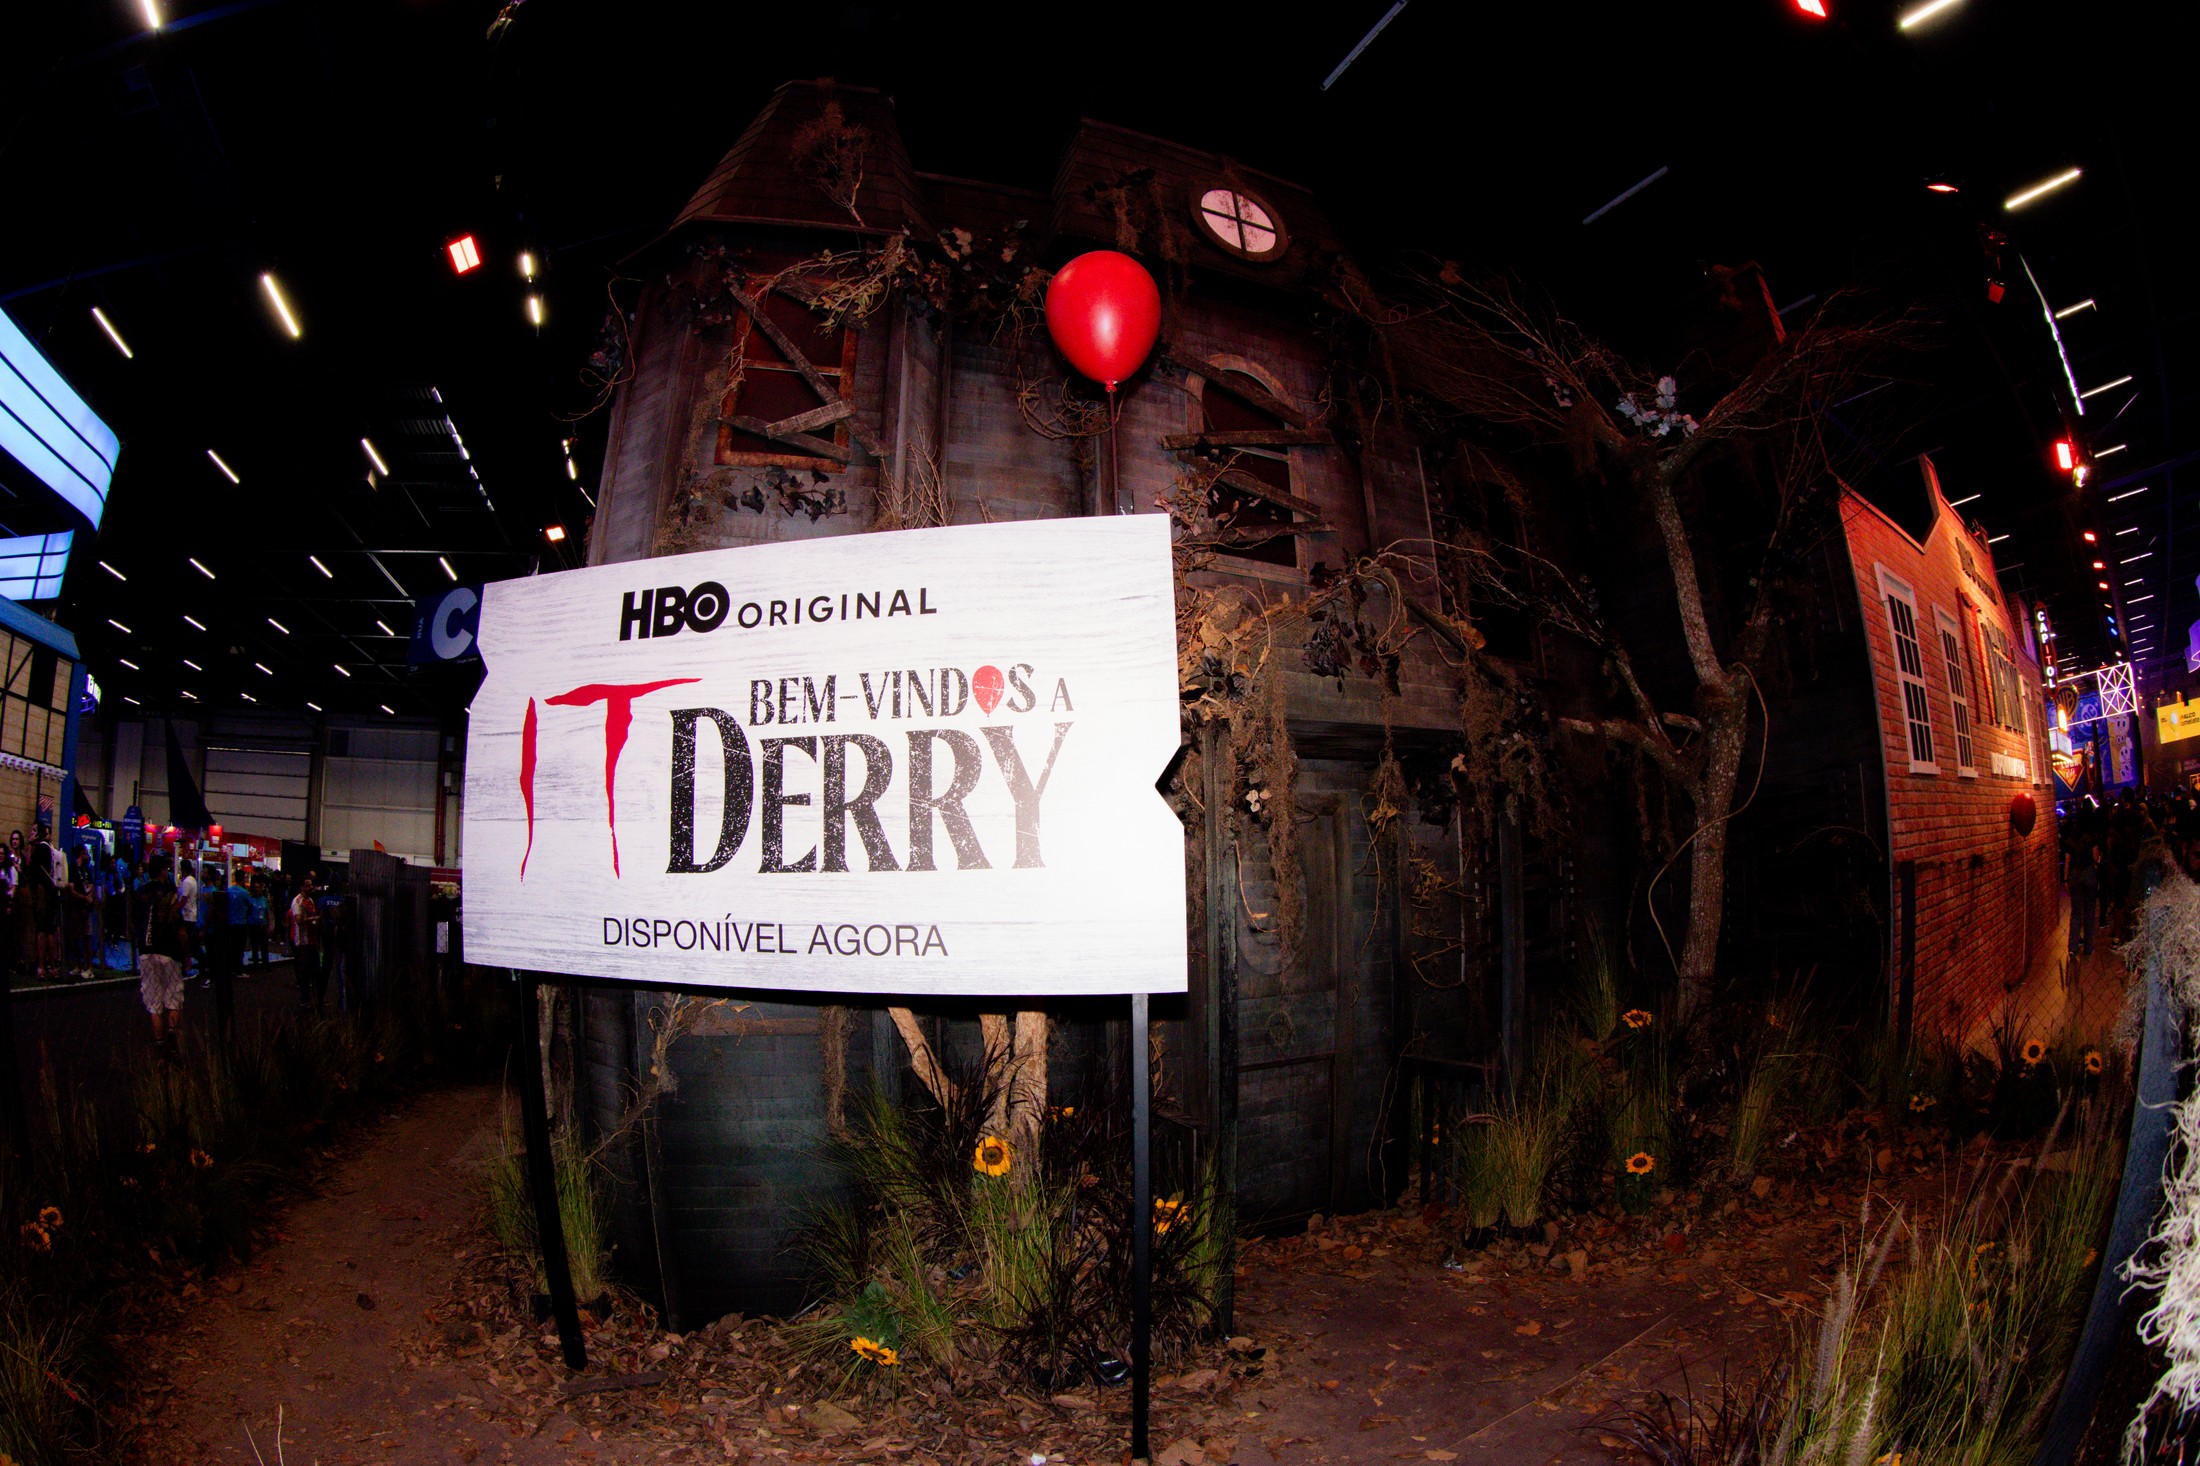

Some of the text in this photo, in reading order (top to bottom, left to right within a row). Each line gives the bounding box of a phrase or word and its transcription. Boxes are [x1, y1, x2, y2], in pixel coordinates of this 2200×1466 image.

[431, 587, 478, 660] C
[619, 581, 937, 642] HBO ORIGINAL
[2036, 610, 2056, 689] CAPITOL
[749, 663, 1075, 727] BEM-VINDOS A
[519, 677, 703, 880] IT
[665, 707, 1075, 875] DERRY
[603, 913, 949, 957] DISPONÍVEL AGORA
